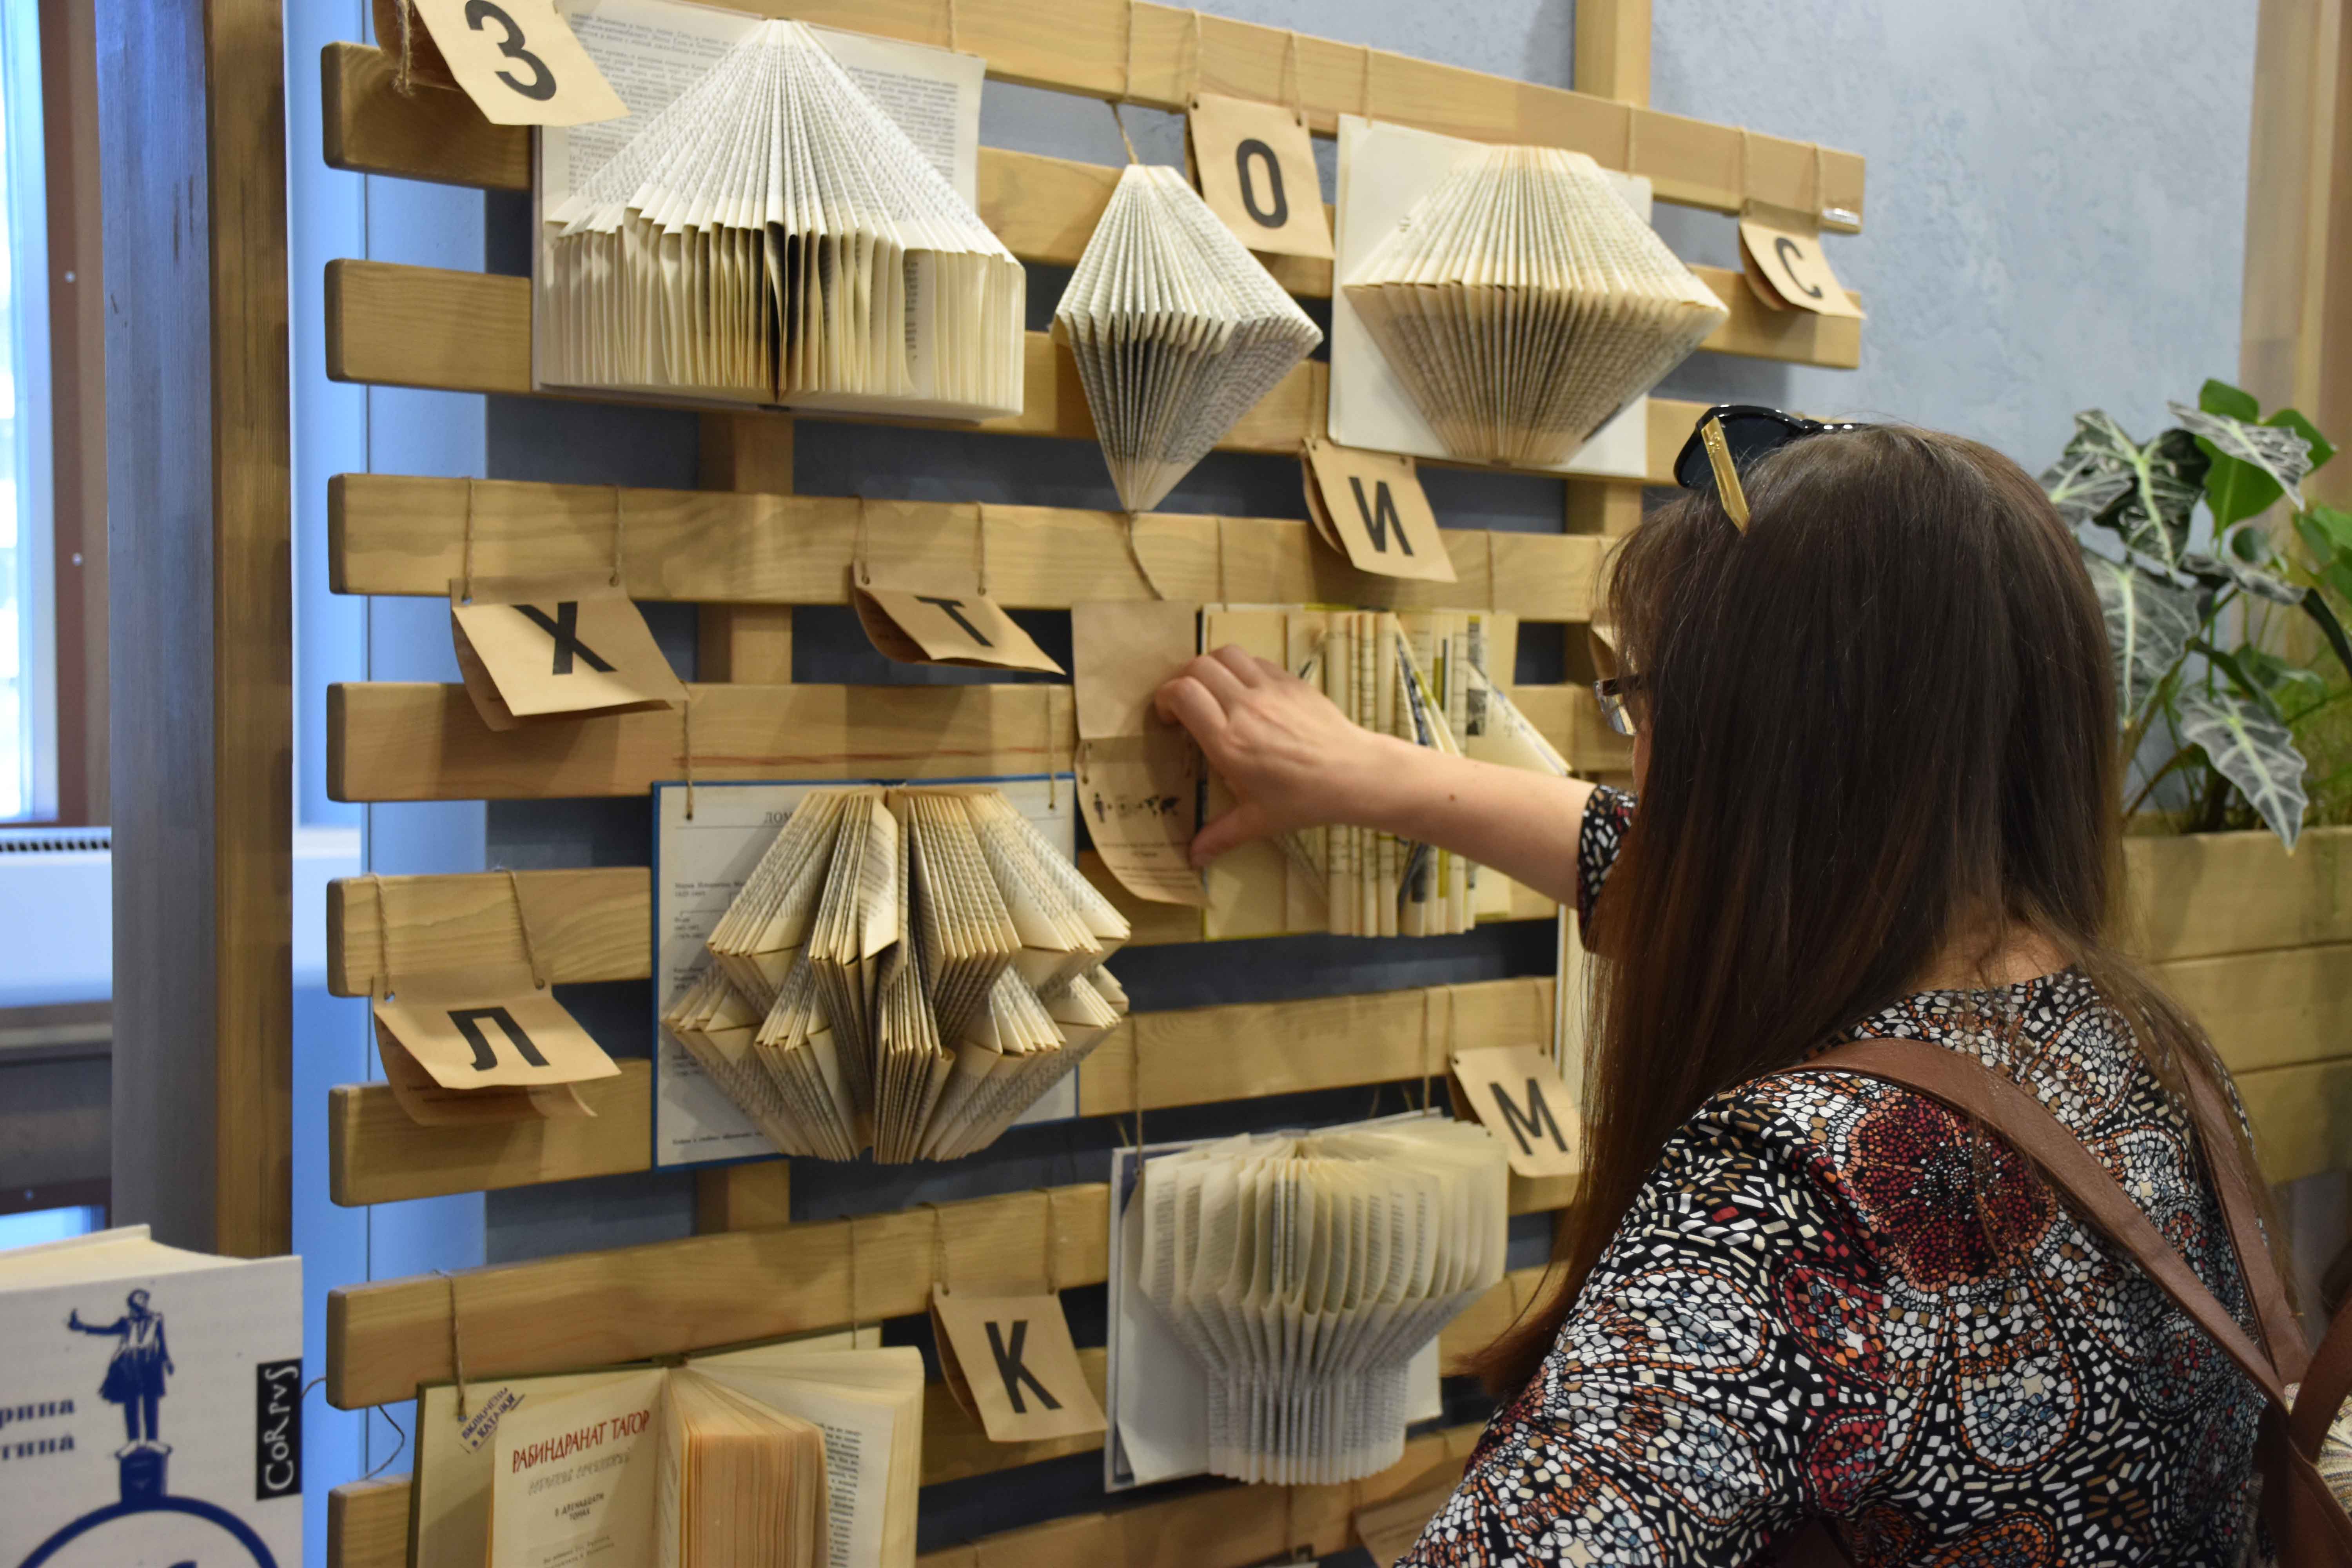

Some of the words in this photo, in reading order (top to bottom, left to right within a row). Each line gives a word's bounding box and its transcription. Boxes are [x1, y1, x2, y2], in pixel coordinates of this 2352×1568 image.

[1236, 138, 1288, 229] О
[1775, 238, 1822, 300] С
[1348, 476, 1415, 558] И
[511, 601, 618, 675] Х
[915, 595, 994, 648] Т
[447, 1007, 551, 1071] Л
[1488, 1077, 1568, 1156] М
[985, 1319, 1063, 1414] К
[512, 1422, 607, 1474] РАБИНДРАНАТ
[611, 1410, 650, 1440] ТАГОР
